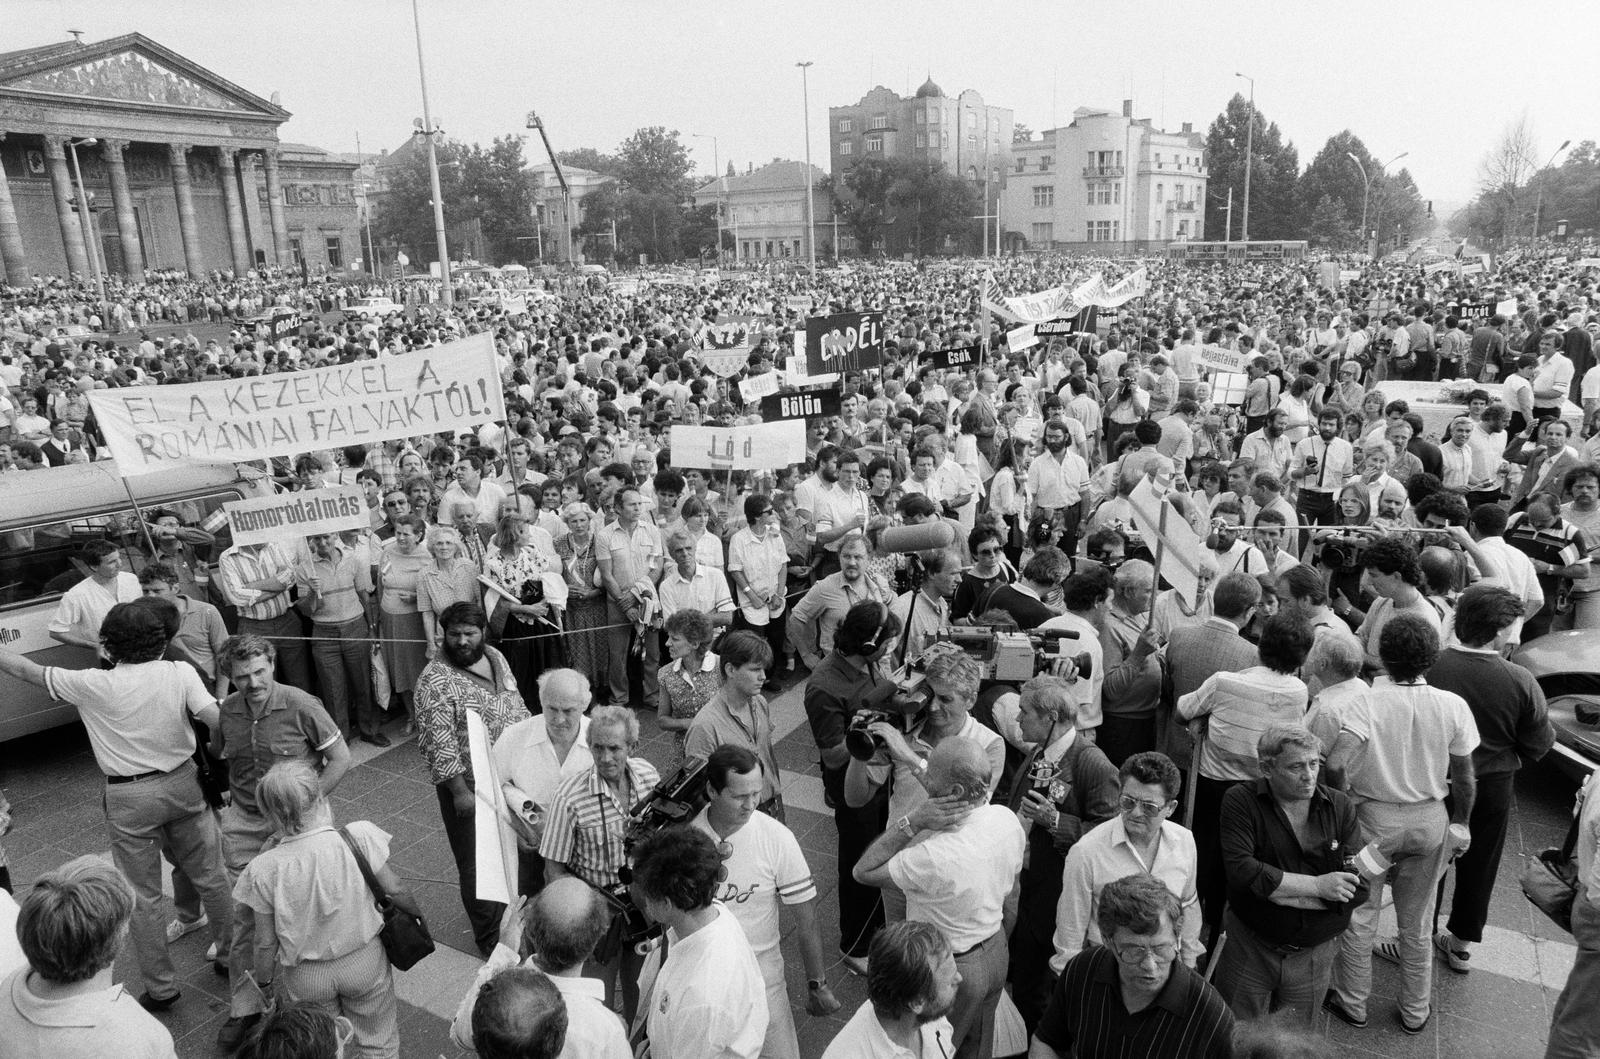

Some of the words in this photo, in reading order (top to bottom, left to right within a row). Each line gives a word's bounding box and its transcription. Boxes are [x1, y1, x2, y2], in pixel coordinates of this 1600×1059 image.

[820, 315, 884, 362] ERDÉL
[122, 396, 176, 425] EL
[189, 394, 212, 423] A
[223, 363, 402, 416] KEZEKKEL
[416, 359, 441, 390] A
[780, 394, 822, 418] Bölön
[135, 414, 299, 465] ROMÁNIAI
[307, 377, 492, 441] FALVAKTÓL!
[230, 493, 360, 533] Homoródalmás
